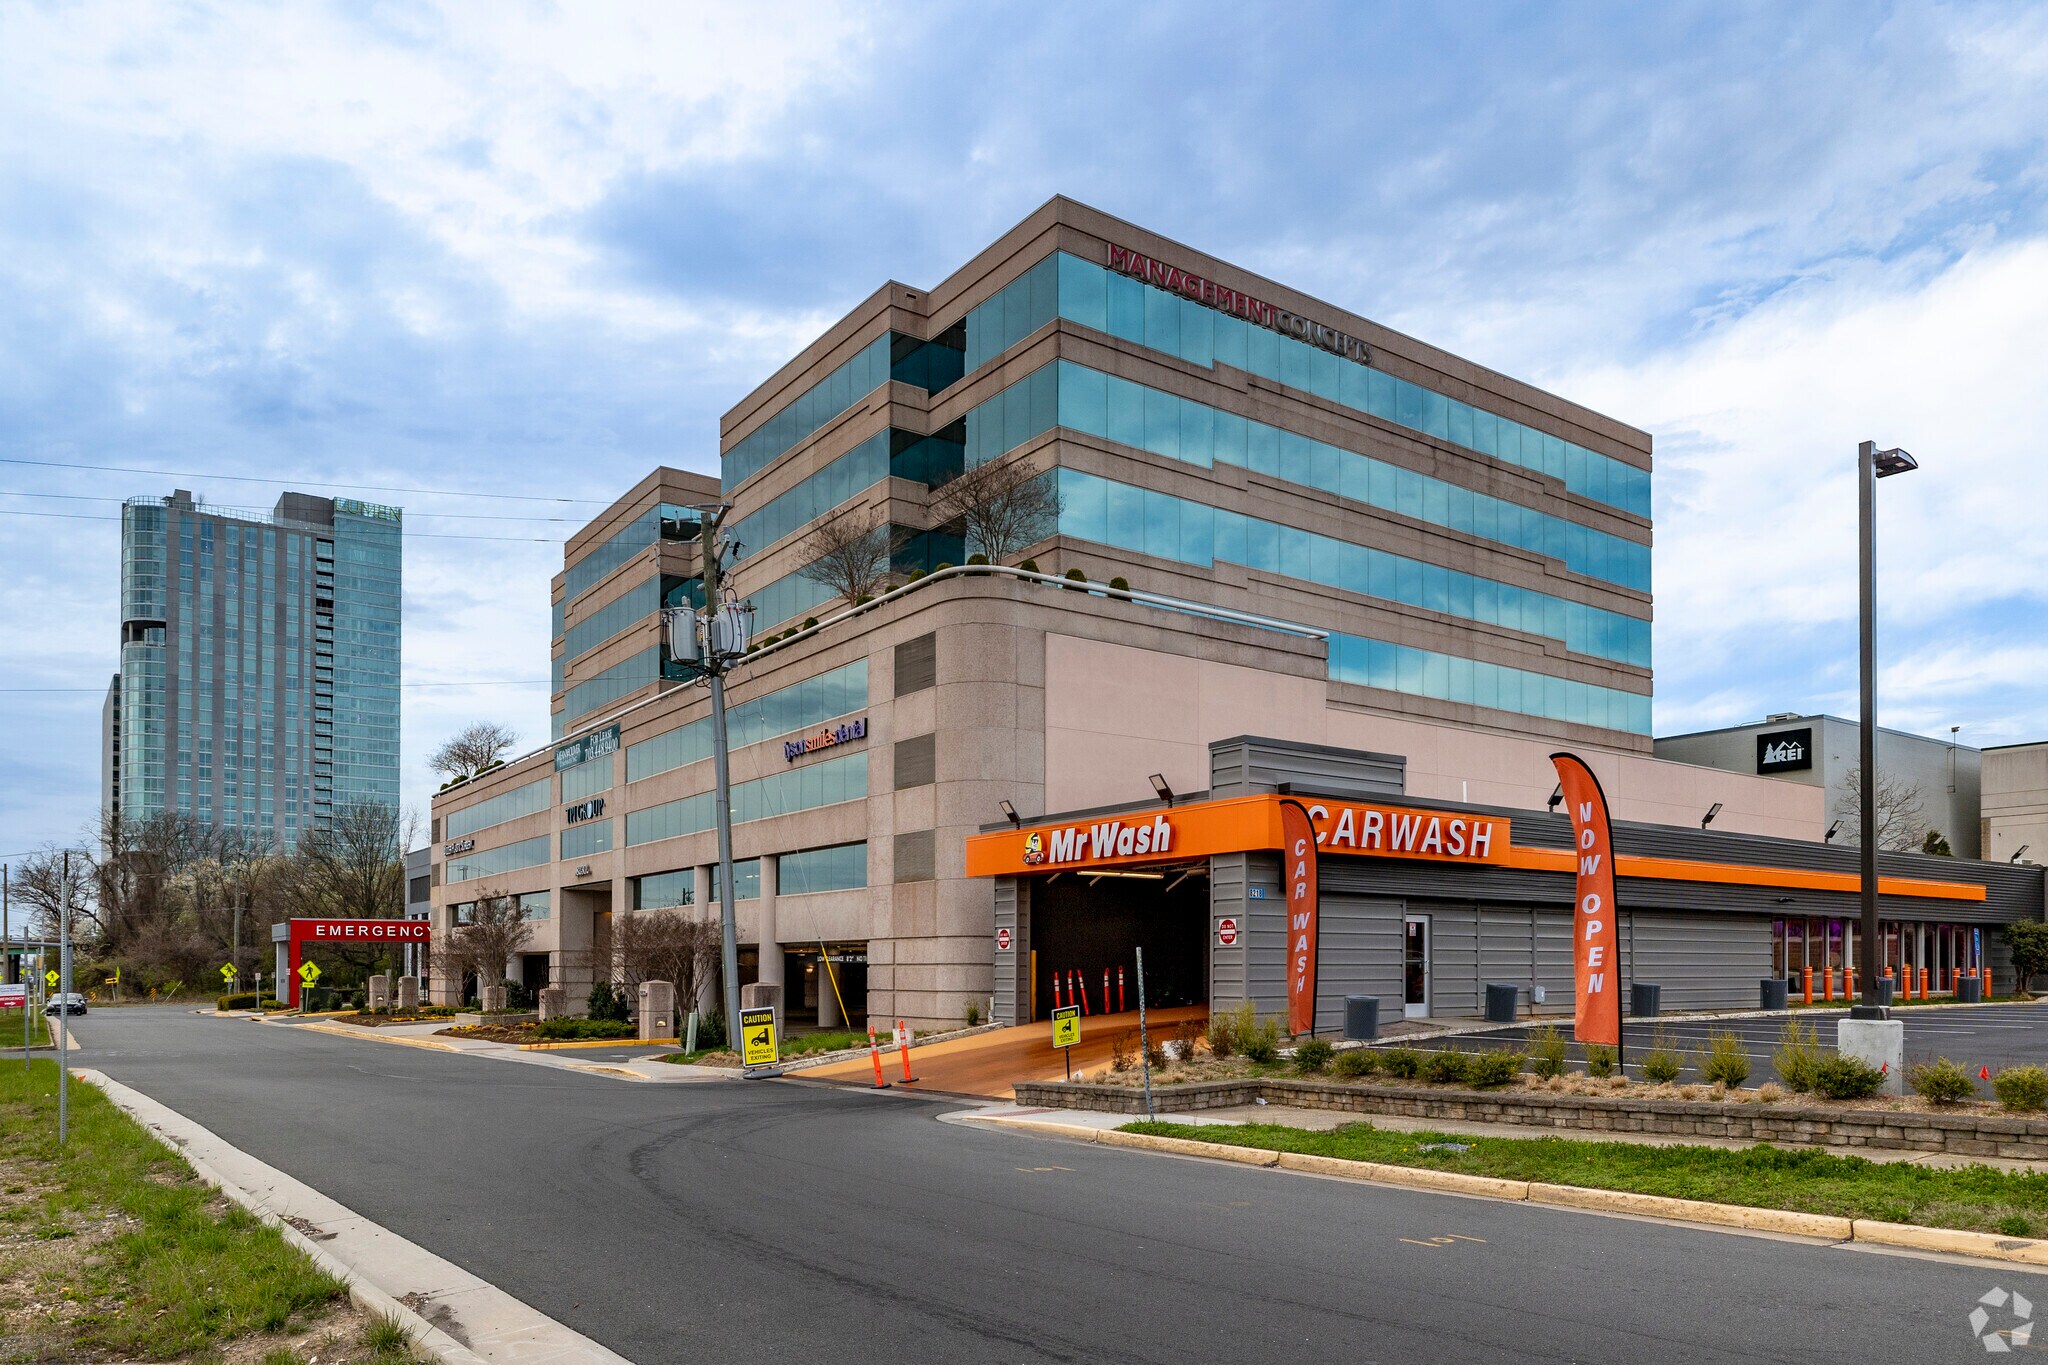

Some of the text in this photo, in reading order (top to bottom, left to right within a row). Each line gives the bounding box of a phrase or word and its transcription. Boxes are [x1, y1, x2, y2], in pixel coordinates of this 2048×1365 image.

[1579, 801, 1604, 994] NOW OPEN
[1293, 838, 1309, 995] CAR WASH
[743, 1013, 772, 1024] CAUTION
[1056, 1010, 1076, 1020] CAUTION
[747, 1048, 774, 1056] VEHICLES
